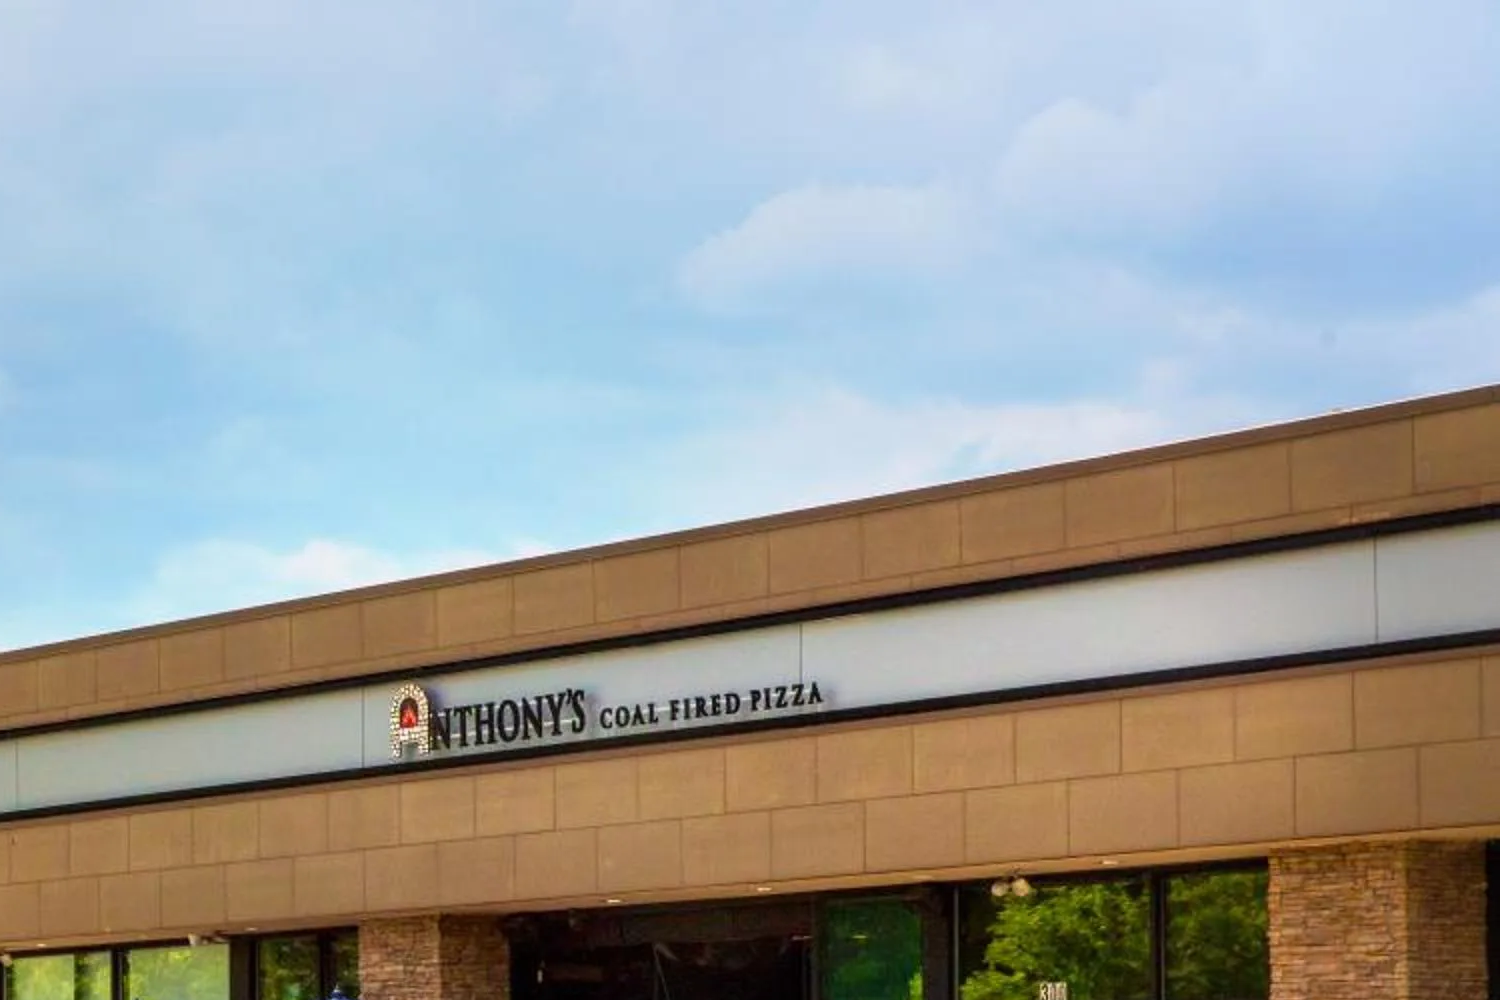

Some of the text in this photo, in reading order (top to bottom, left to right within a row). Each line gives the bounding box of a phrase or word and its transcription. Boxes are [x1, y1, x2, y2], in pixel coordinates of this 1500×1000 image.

[389, 681, 824, 758] ANTHONY'S COAL FIRED PIZZA
